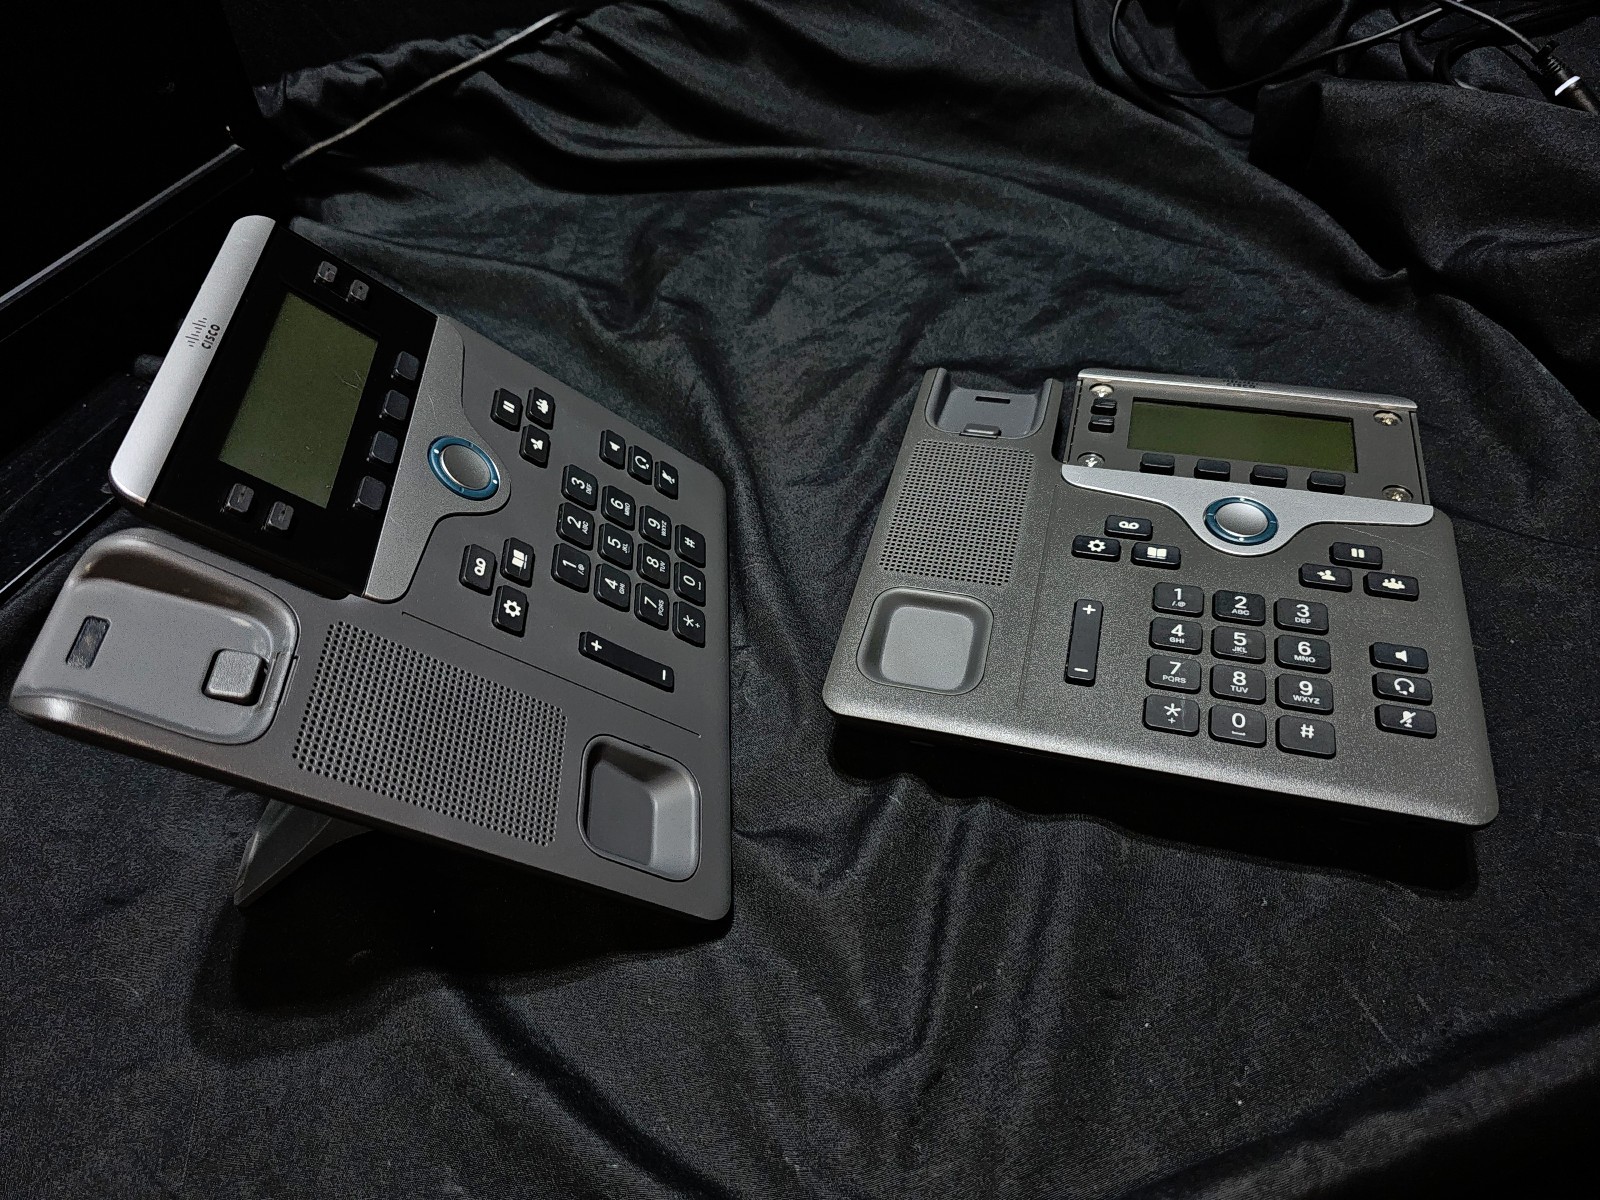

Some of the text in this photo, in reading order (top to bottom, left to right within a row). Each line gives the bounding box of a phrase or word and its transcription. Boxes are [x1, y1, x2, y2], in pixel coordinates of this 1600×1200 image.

[201, 324, 220, 349] CISCO
[571, 477, 585, 489] 3
[611, 498, 623, 509] 6
[567, 516, 581, 529] 2
[648, 518, 660, 529] 9
[608, 536, 621, 548] 5
[684, 537, 695, 548] #
[562, 559, 576, 568] 1
[646, 556, 659, 568] 8
[605, 578, 618, 590] 4
[683, 575, 695, 586] 0
[1174, 588, 1181, 600] 1
[644, 596, 657, 608] 7
[1234, 596, 1247, 608] 2
[1296, 604, 1309, 617] 3
[1171, 624, 1184, 636] 4
[1234, 632, 1247, 645] 5
[1298, 642, 1311, 655] 6
[1294, 655, 1316, 663] MNO
[1170, 661, 1182, 674] 7
[1162, 675, 1187, 683] PQRS
[1233, 671, 1246, 685] 8
[1230, 685, 1248, 693] TUV
[1299, 681, 1313, 695] 9
[1293, 695, 1320, 704] WXYZ
[1232, 713, 1246, 728] 0
[1300, 724, 1314, 739] #
